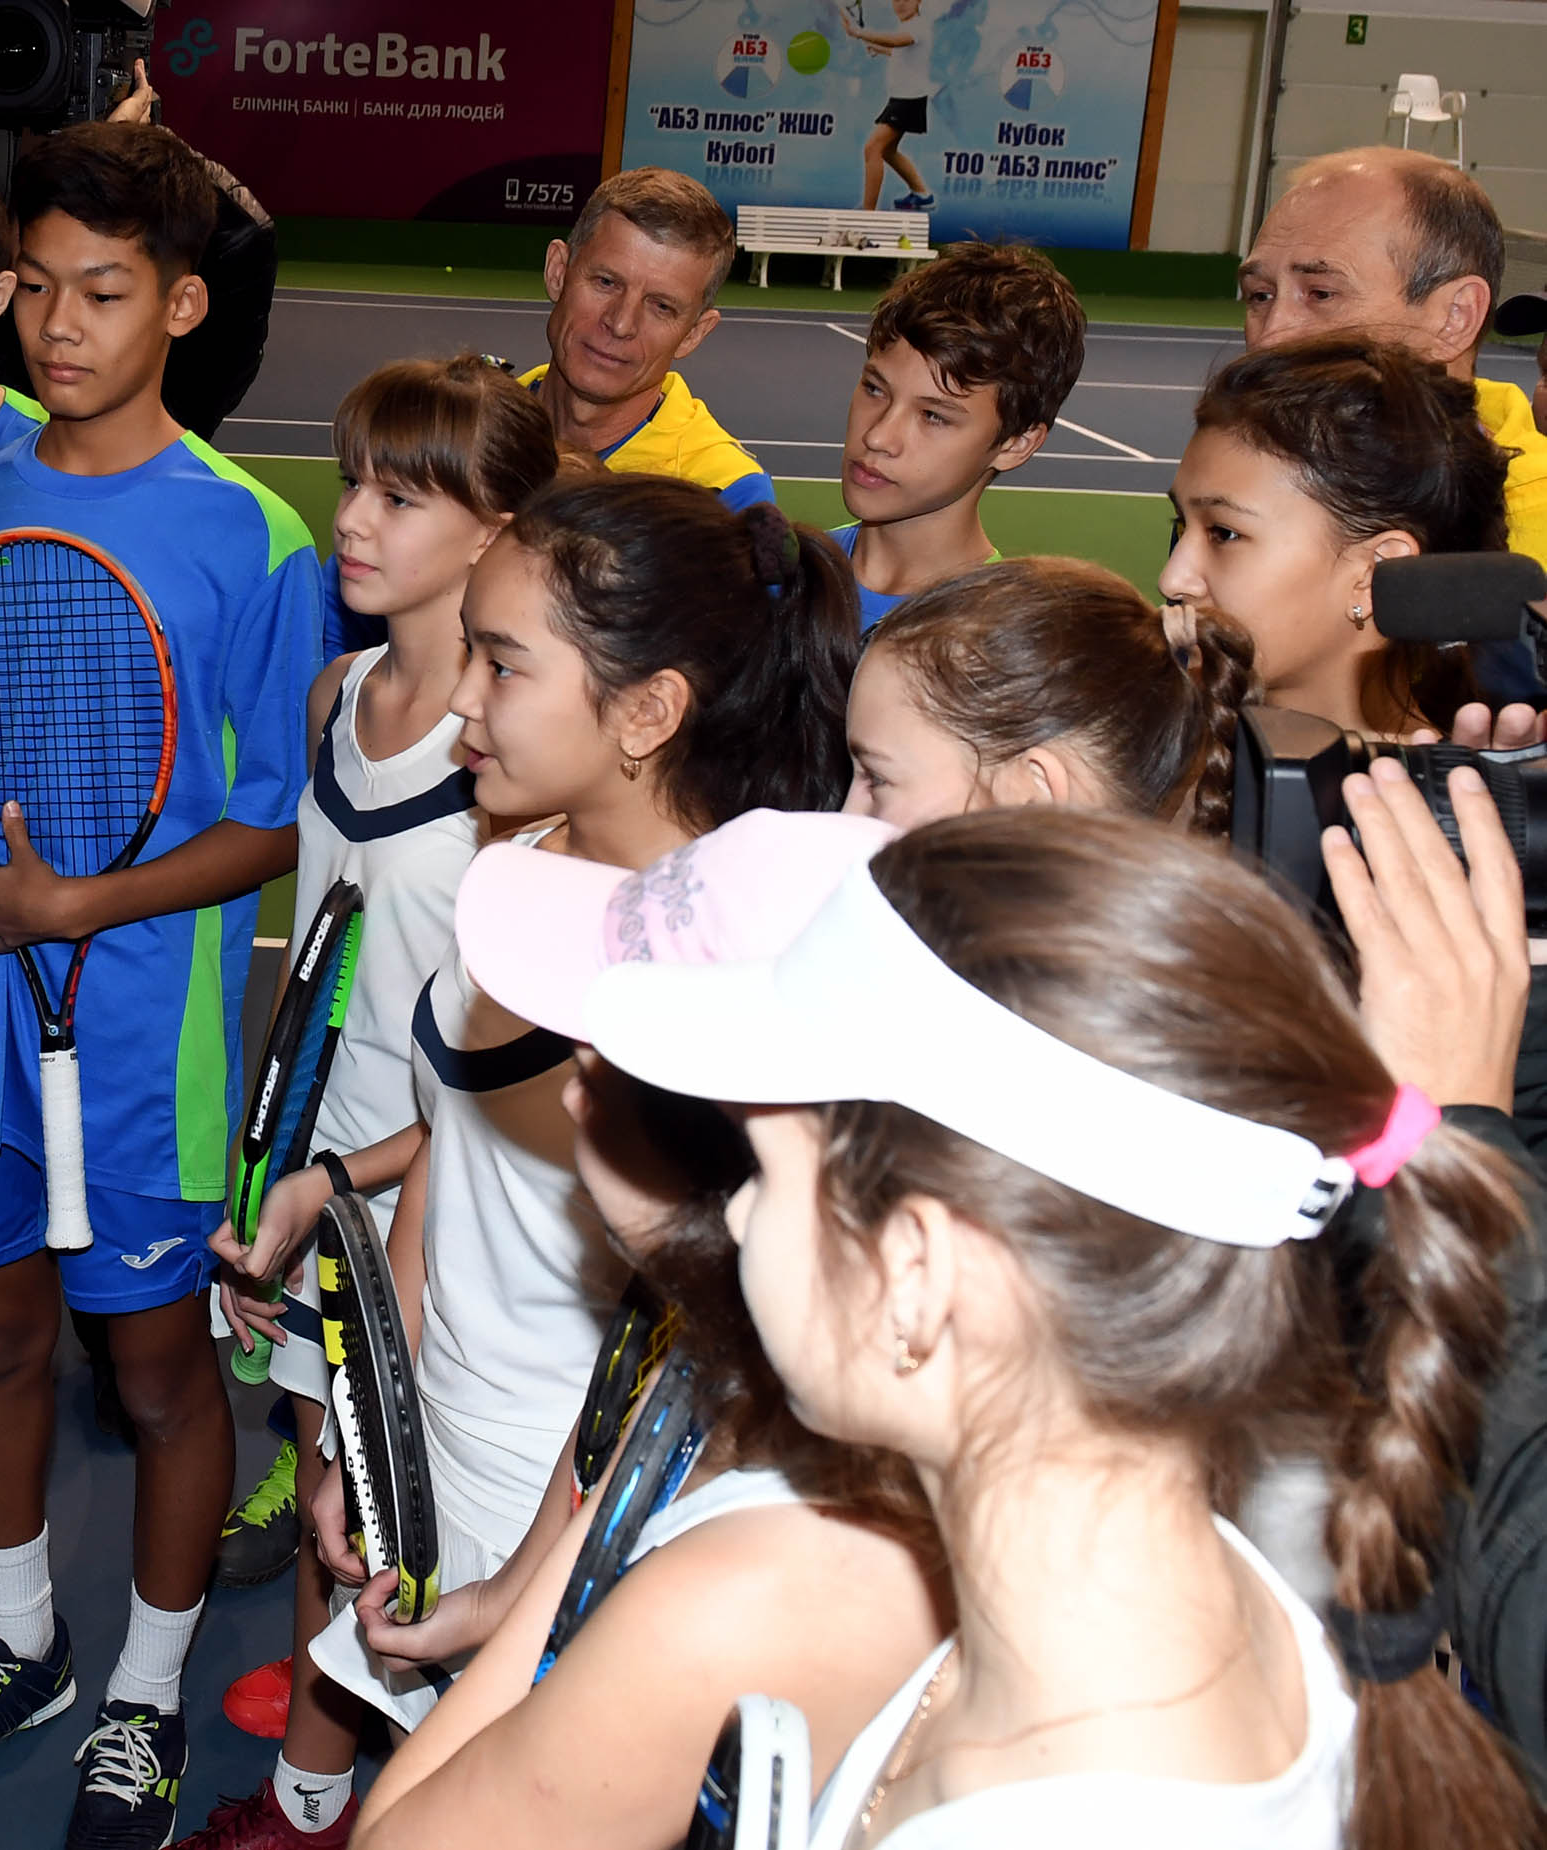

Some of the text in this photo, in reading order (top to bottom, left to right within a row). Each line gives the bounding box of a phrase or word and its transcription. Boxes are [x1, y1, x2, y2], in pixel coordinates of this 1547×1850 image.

[233, 26, 507, 82] ForteBank
[733, 40, 768, 56] АБЗ
[1016, 52, 1052, 68] АБЗ
[303, 98, 349, 115] БАНКІ
[363, 101, 405, 116] БАНК
[407, 103, 442, 120] ДЛЯ
[444, 102, 505, 122] ЛЮДЕЙ
[778, 112, 834, 137] ЖШС
[998, 122, 1066, 147] Кубок
[706, 140, 776, 165] Кубогі
[944, 151, 984, 175] ТОО
[525, 183, 575, 204] 7575
